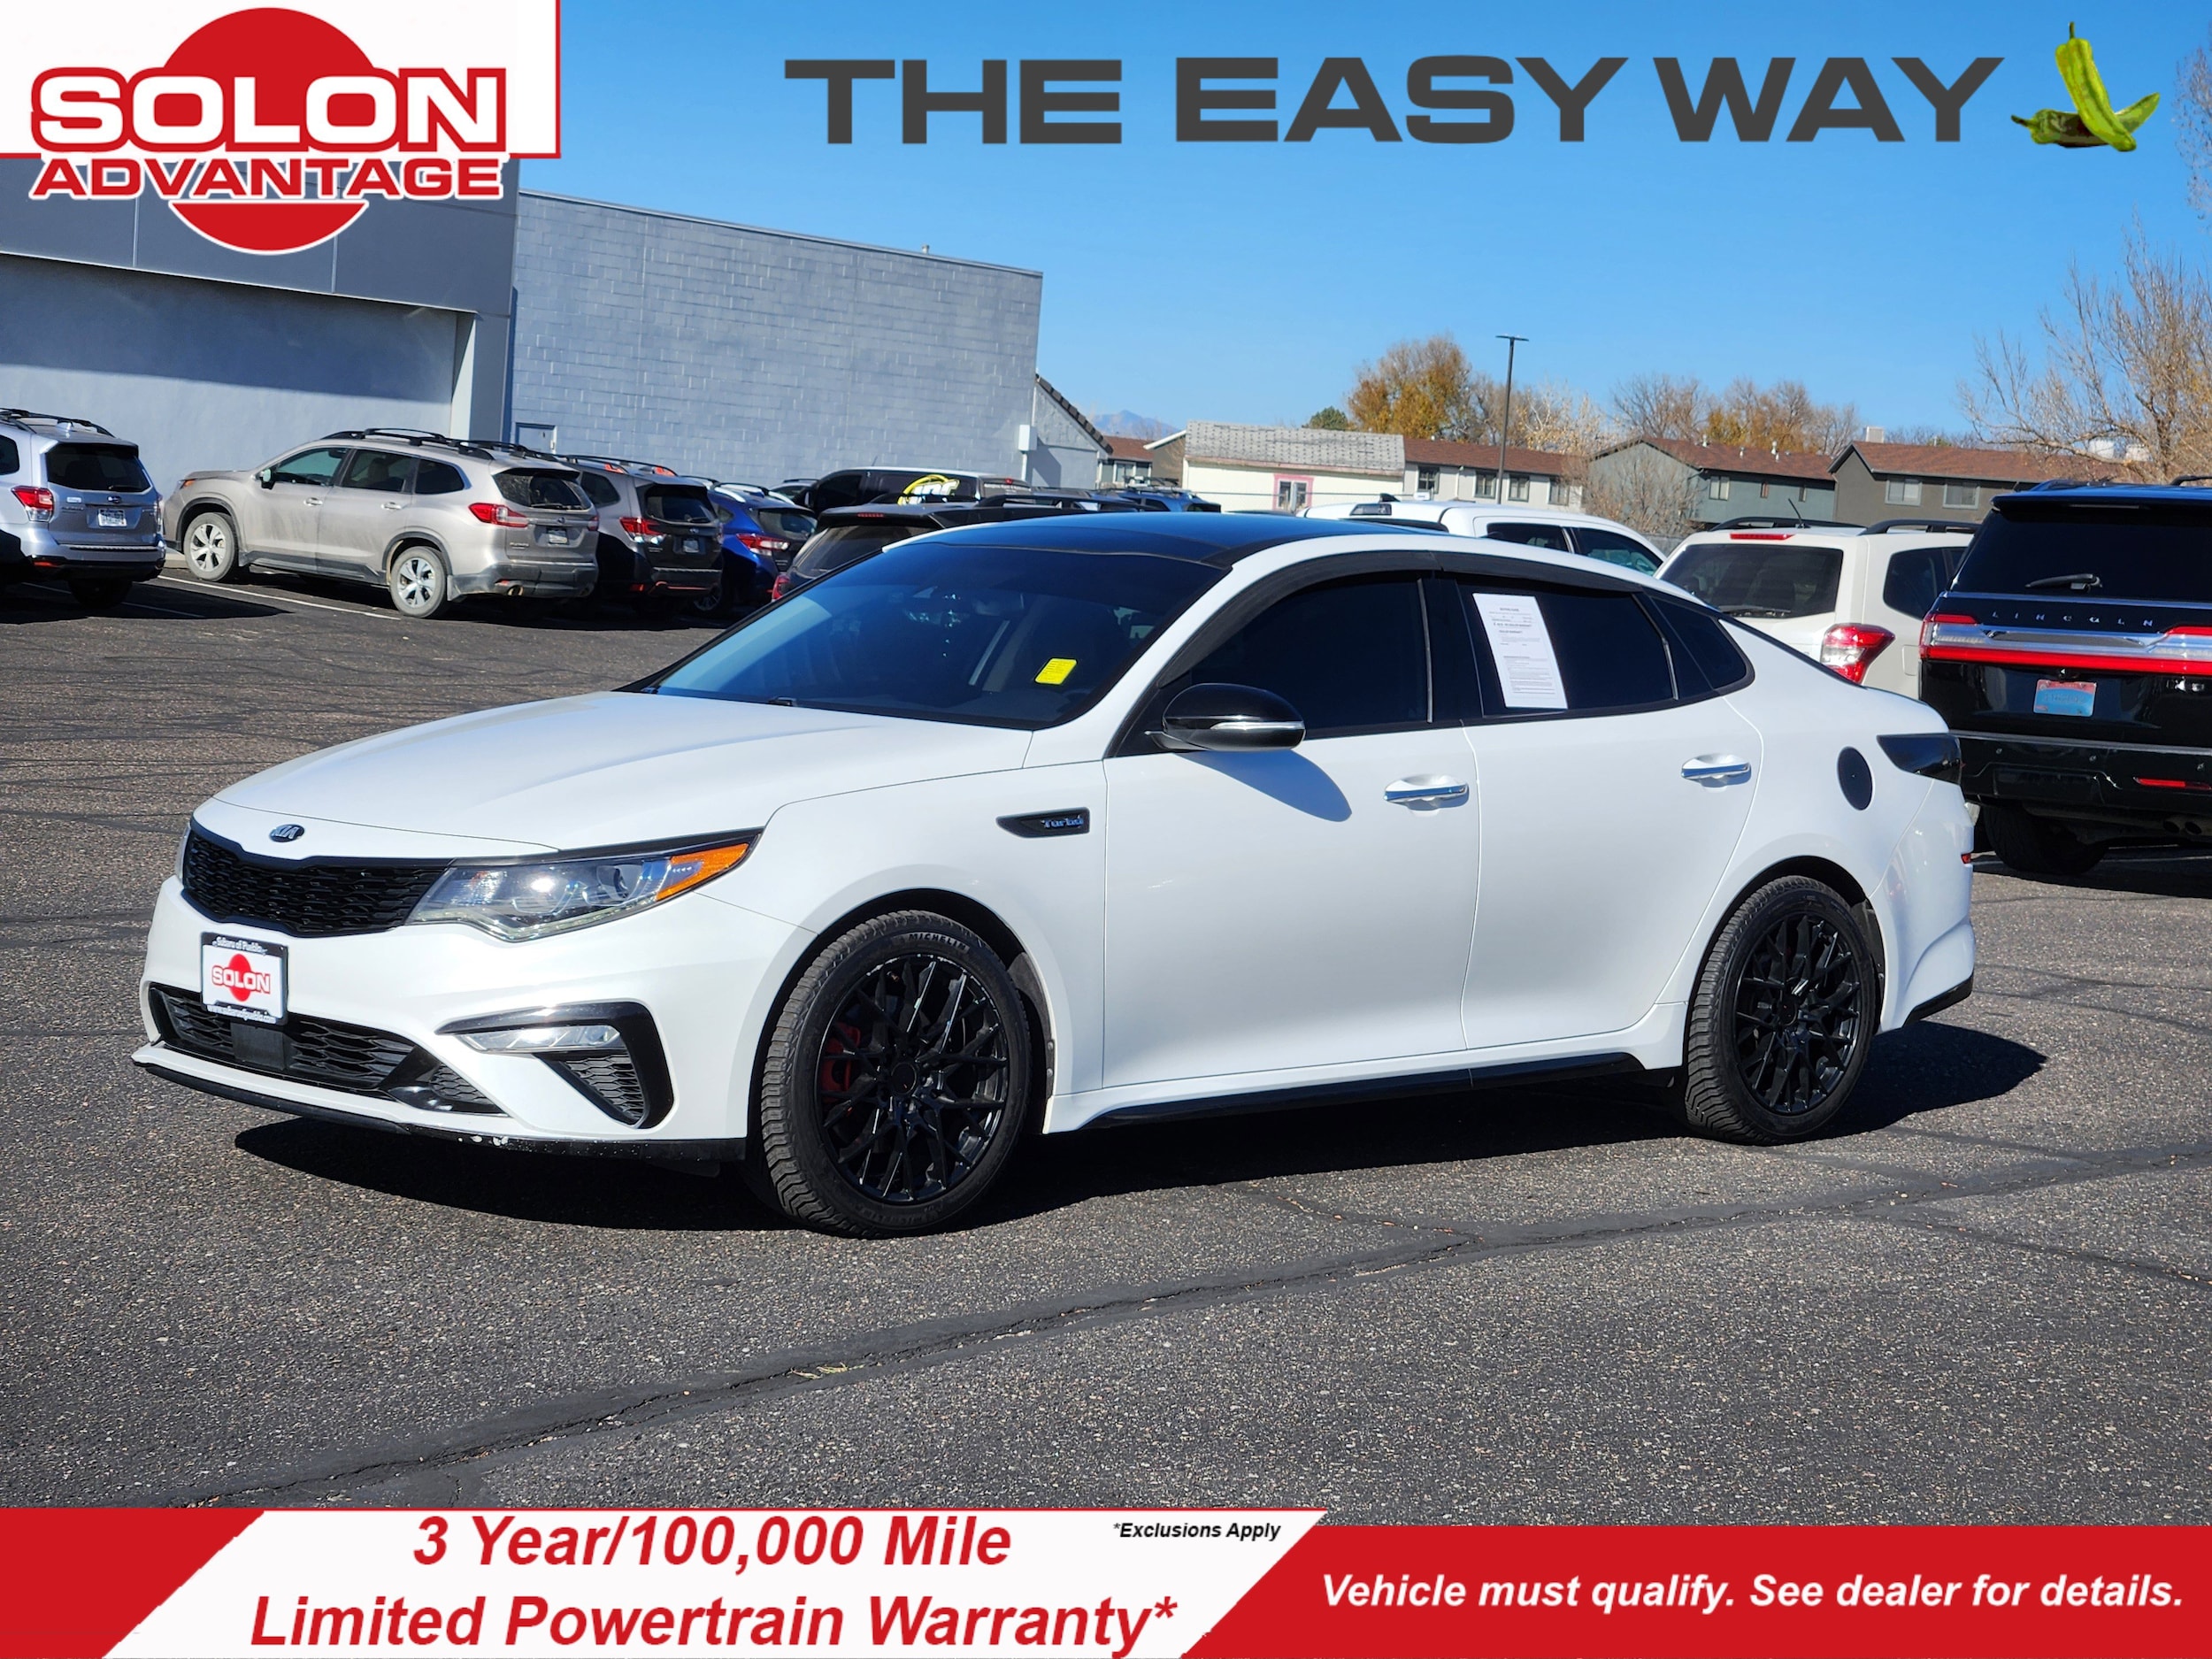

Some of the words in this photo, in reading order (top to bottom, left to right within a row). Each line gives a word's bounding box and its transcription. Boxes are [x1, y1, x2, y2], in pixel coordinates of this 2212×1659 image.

[1992, 611, 2154, 627] LINCOLN
[1041, 814, 1085, 829] Turbo
[271, 825, 300, 840] KIA
[909, 932, 968, 951] MICHELIN
[212, 965, 271, 994] SOLON
